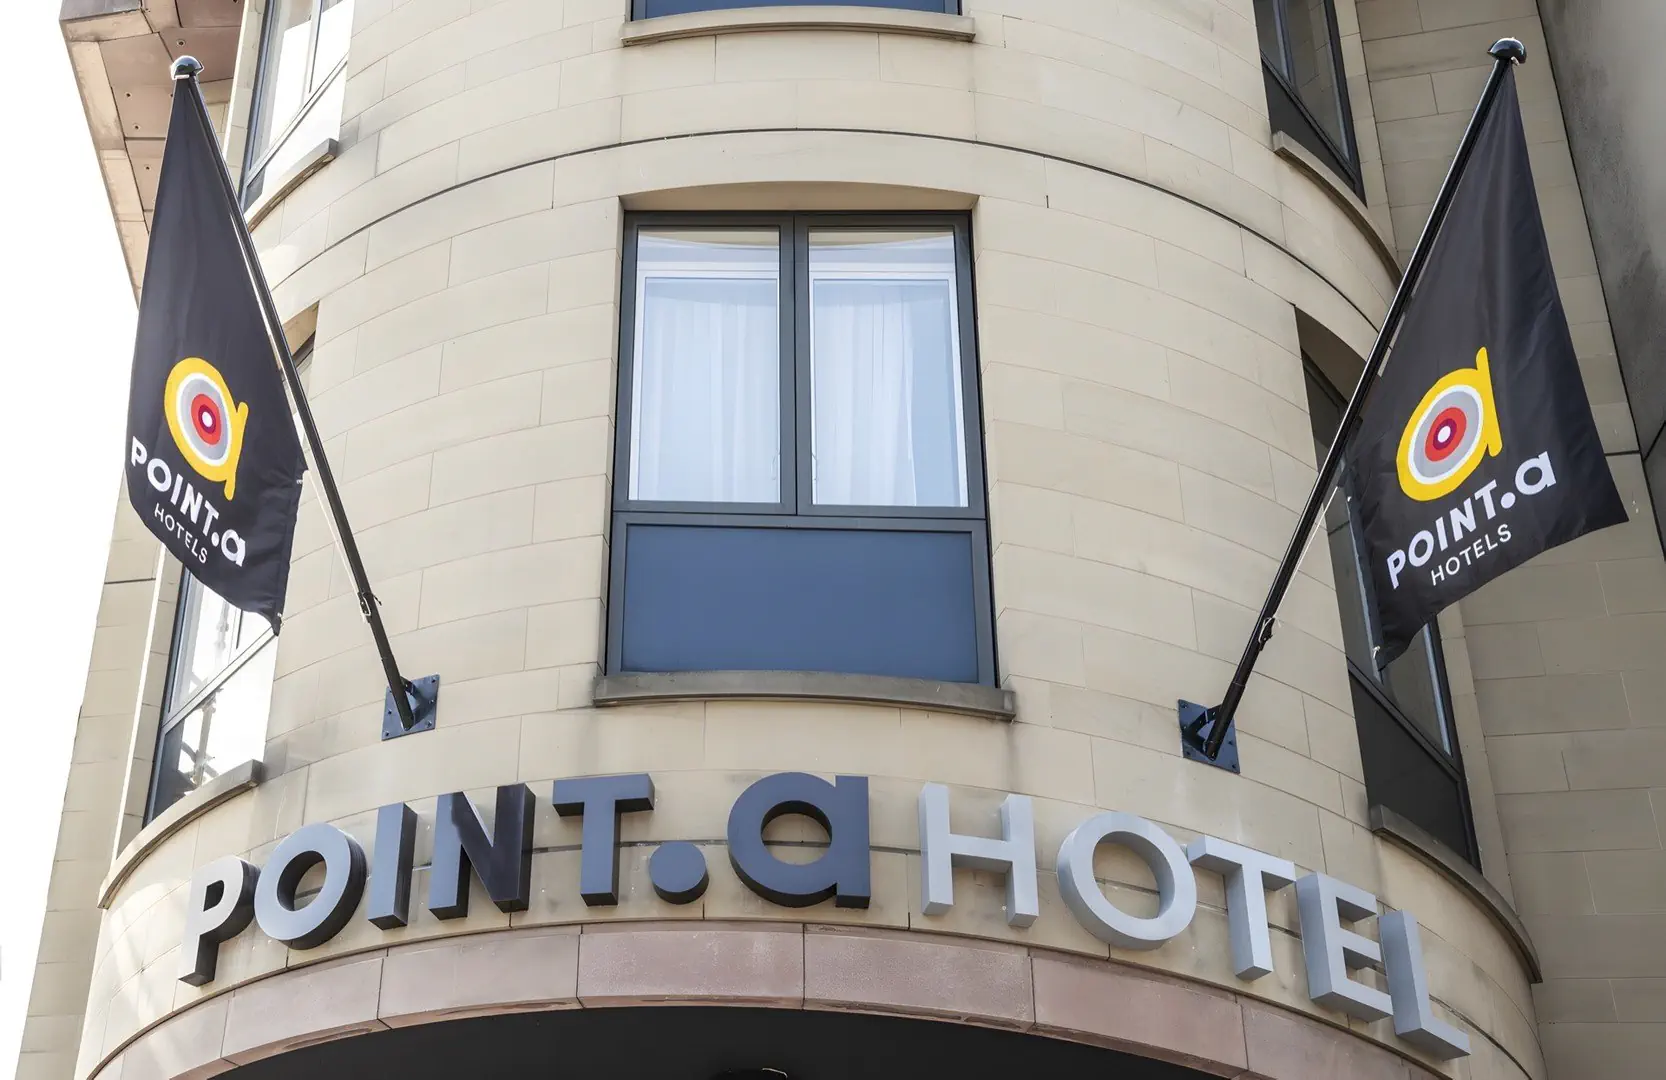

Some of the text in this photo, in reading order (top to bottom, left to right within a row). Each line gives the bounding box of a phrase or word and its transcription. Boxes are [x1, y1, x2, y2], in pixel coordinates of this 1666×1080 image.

[131, 436, 246, 567] POINT.a
[154, 502, 208, 564] HOTELS
[1386, 451, 1557, 590] POINT.a
[1430, 523, 1512, 586] HOTELS
[178, 771, 1471, 1060] POINT.a HOTEL
